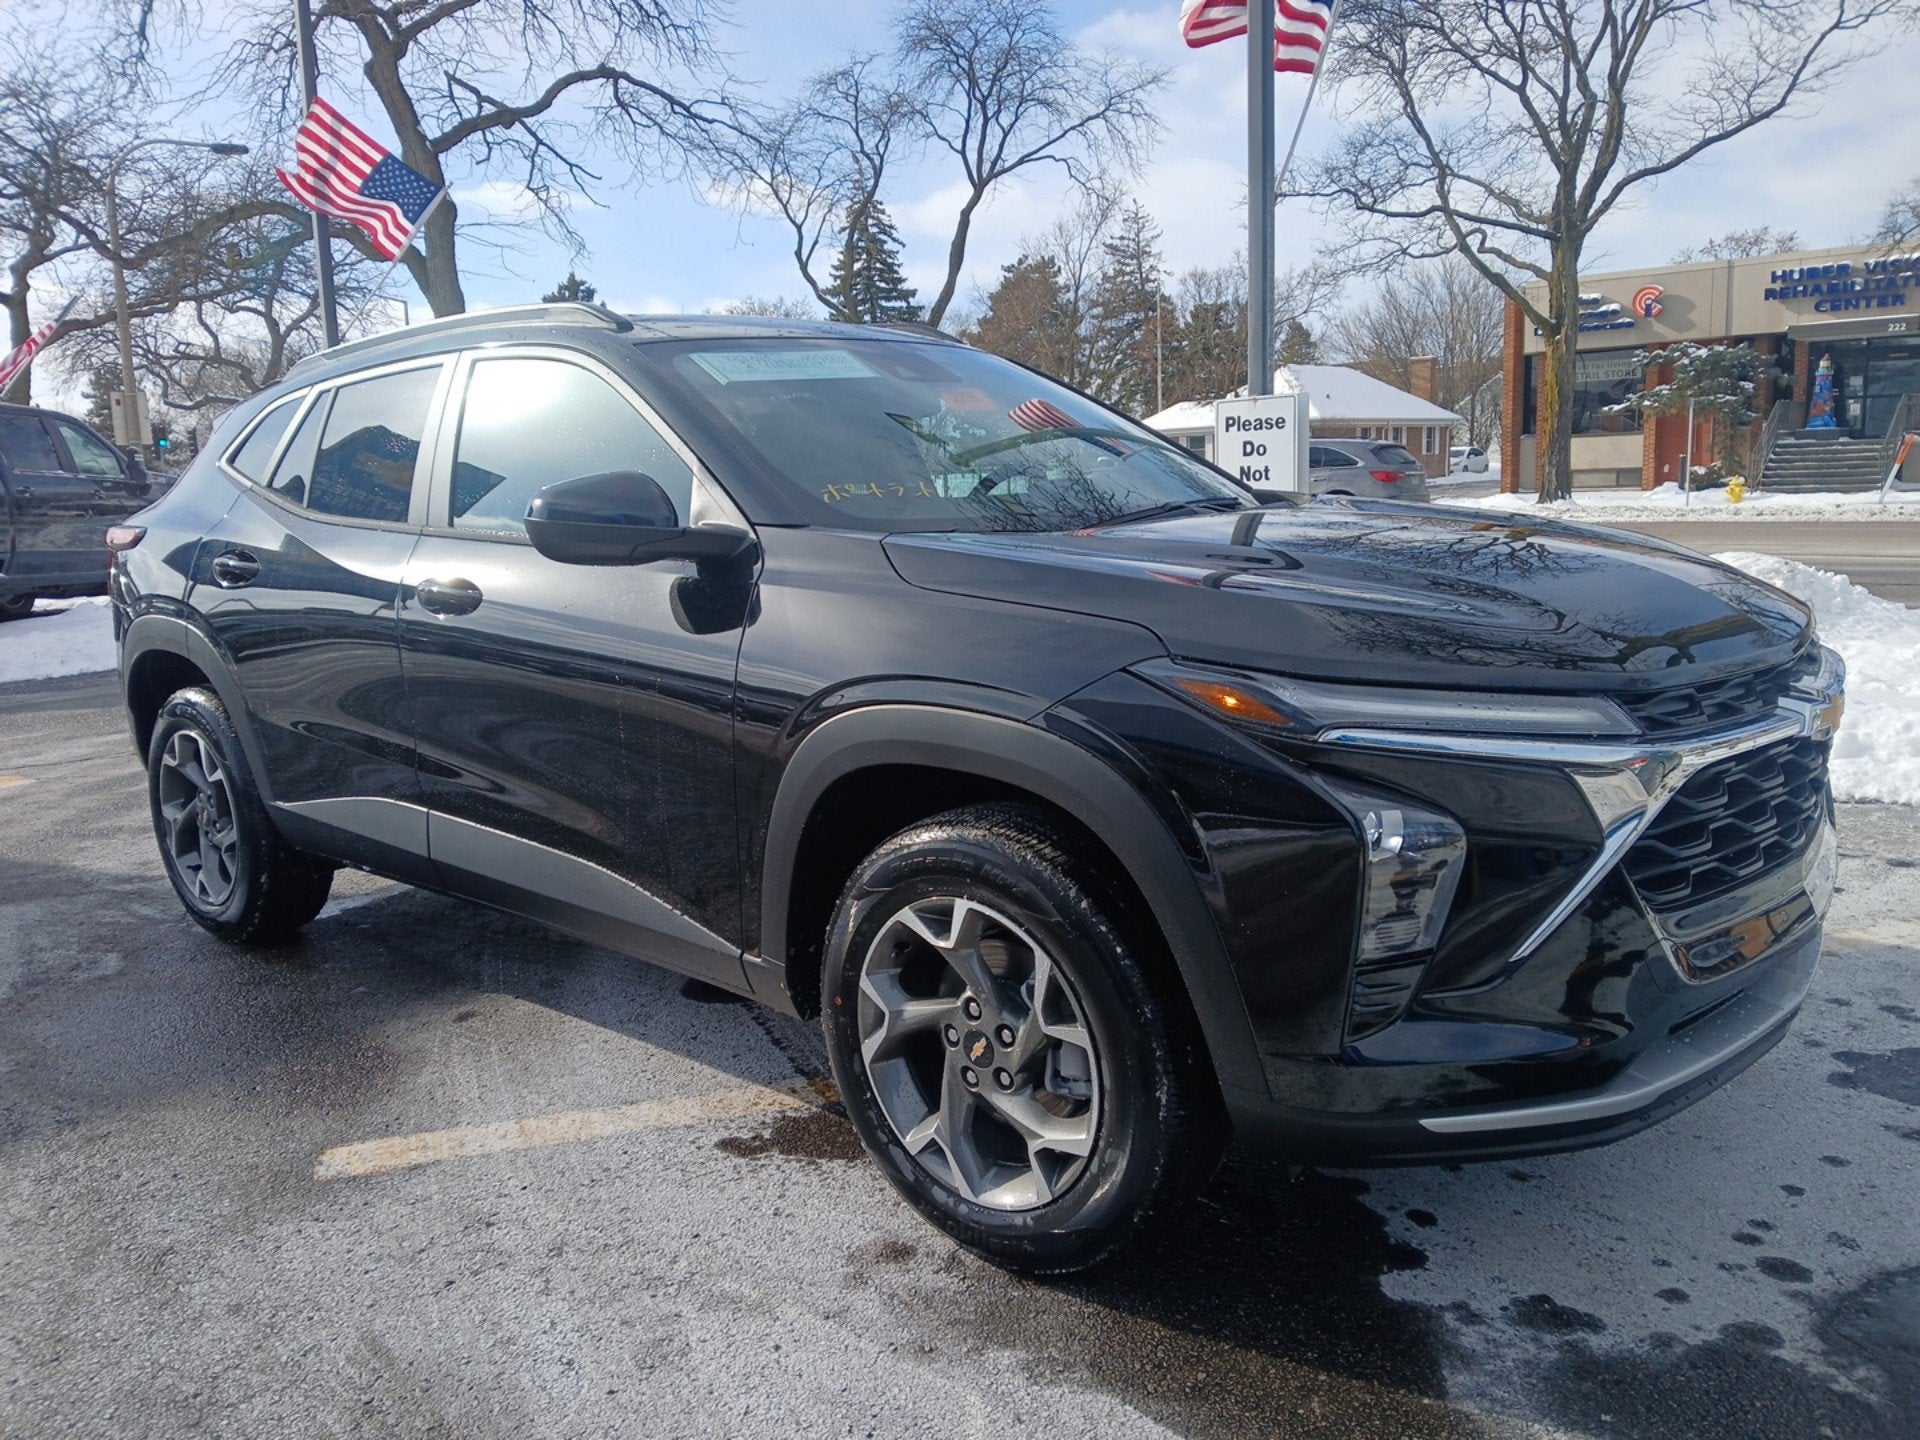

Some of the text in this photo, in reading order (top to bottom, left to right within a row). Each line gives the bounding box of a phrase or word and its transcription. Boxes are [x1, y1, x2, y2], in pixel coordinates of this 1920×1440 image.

[1771, 262, 1852, 284] HUBER
[1814, 294, 1906, 312] CENTER
[1888, 323, 1907, 331] 222
[1575, 368, 1639, 380] ETAIL STORE
[1225, 415, 1286, 433] Please
[1243, 440, 1267, 457] Do
[1240, 465, 1270, 482] Not
